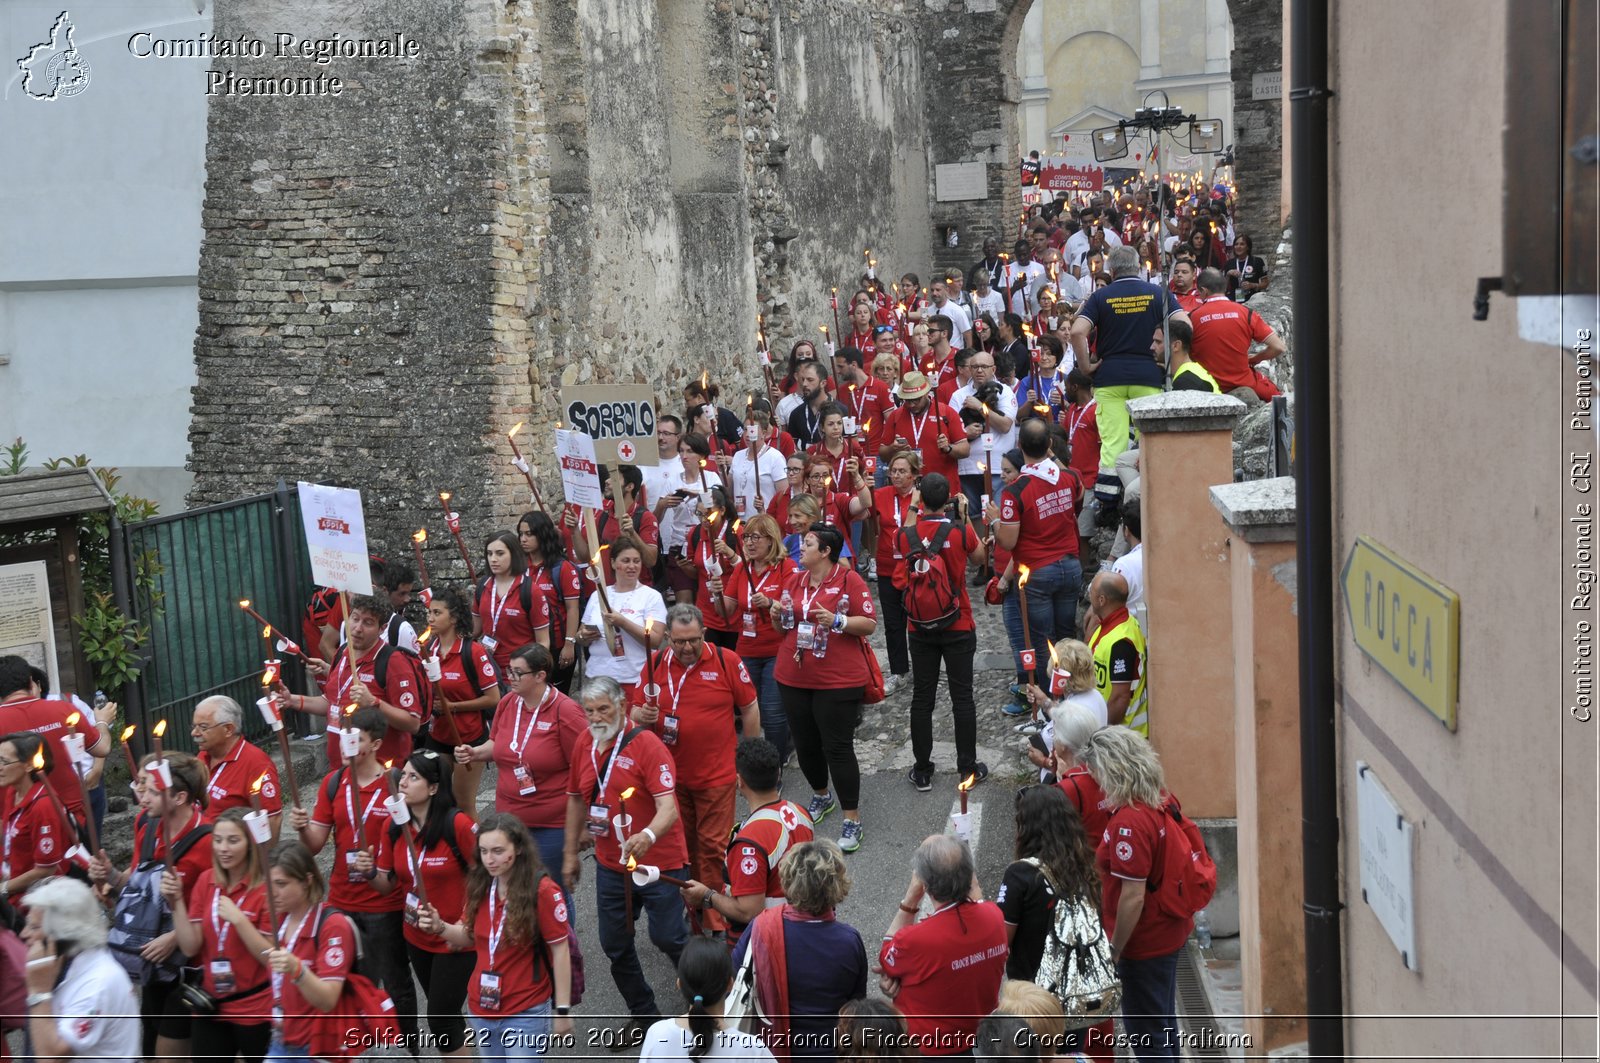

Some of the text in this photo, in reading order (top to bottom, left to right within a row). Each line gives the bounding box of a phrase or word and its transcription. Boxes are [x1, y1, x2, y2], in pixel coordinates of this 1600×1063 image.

[568, 400, 654, 440] SORBOLO
[566, 459, 591, 470] APPIA
[322, 521, 344, 530] APPIA
[1364, 570, 1434, 684] ROCCA
[951, 956, 969, 971] CROCE
[970, 951, 986, 965] ROSSA
